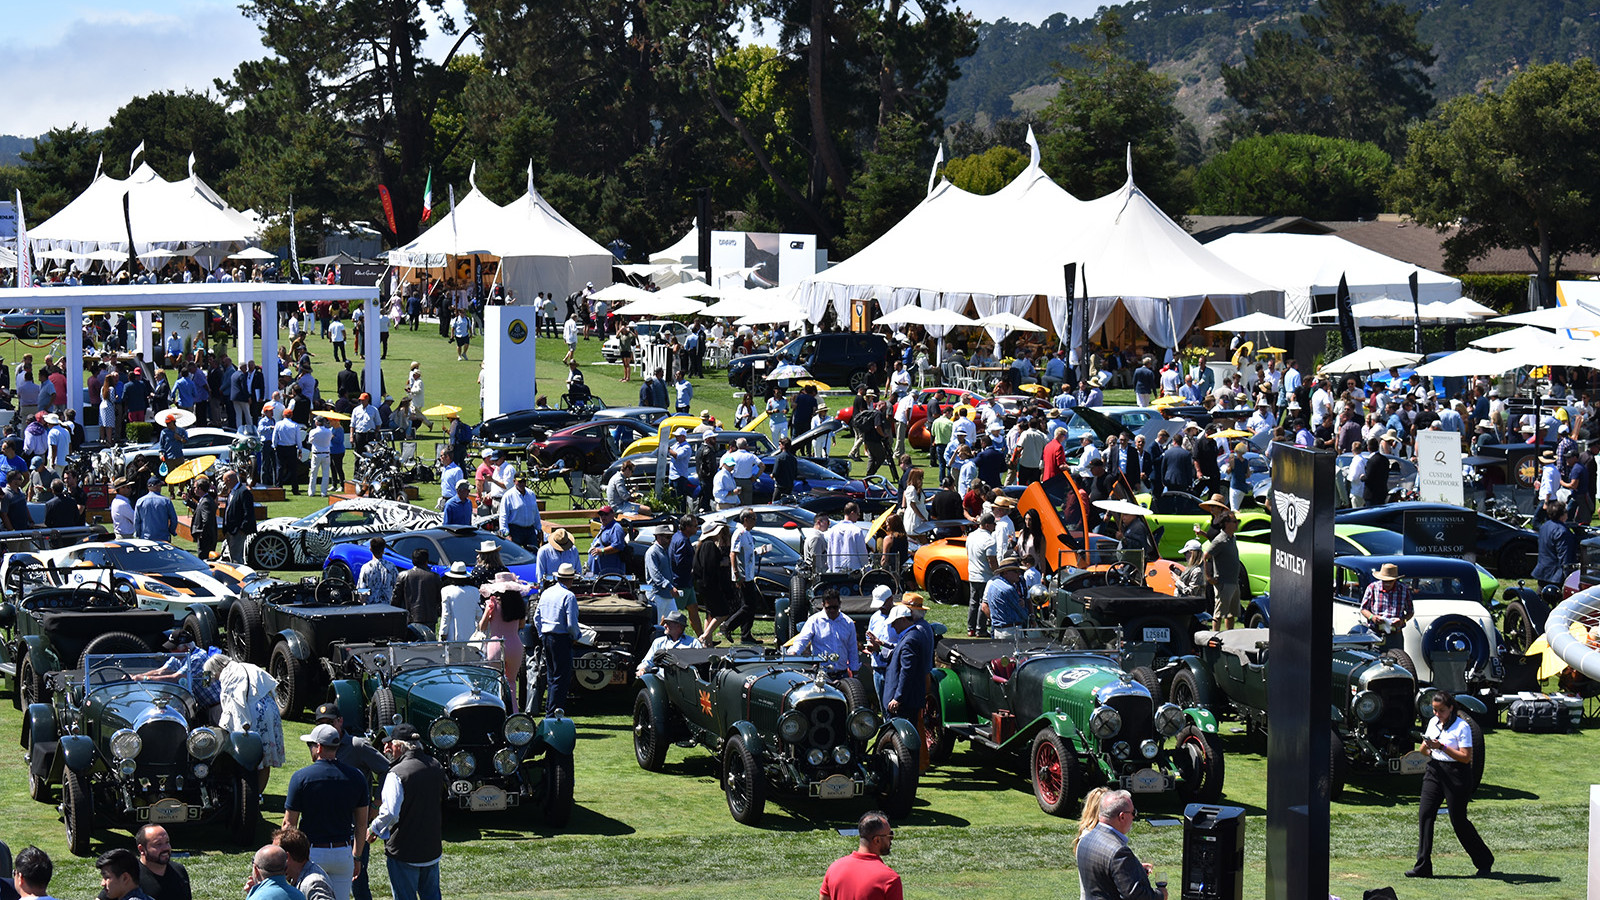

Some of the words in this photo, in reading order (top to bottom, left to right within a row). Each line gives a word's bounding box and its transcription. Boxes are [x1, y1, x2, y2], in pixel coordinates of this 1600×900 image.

[640, 343, 668, 381] BMW
[1423, 479, 1460, 487] COACHWORK
[126, 544, 174, 553] FORD
[1415, 545, 1427, 553] 100
[1428, 545, 1452, 553] YEARS
[1275, 548, 1306, 576] BENTLEY
[588, 659, 616, 669] 6925
[808, 705, 836, 749] 8
[1391, 760, 1400, 771] U
[455, 782, 469, 792] GB
[140, 809, 149, 820] U
[188, 807, 198, 819] 9
